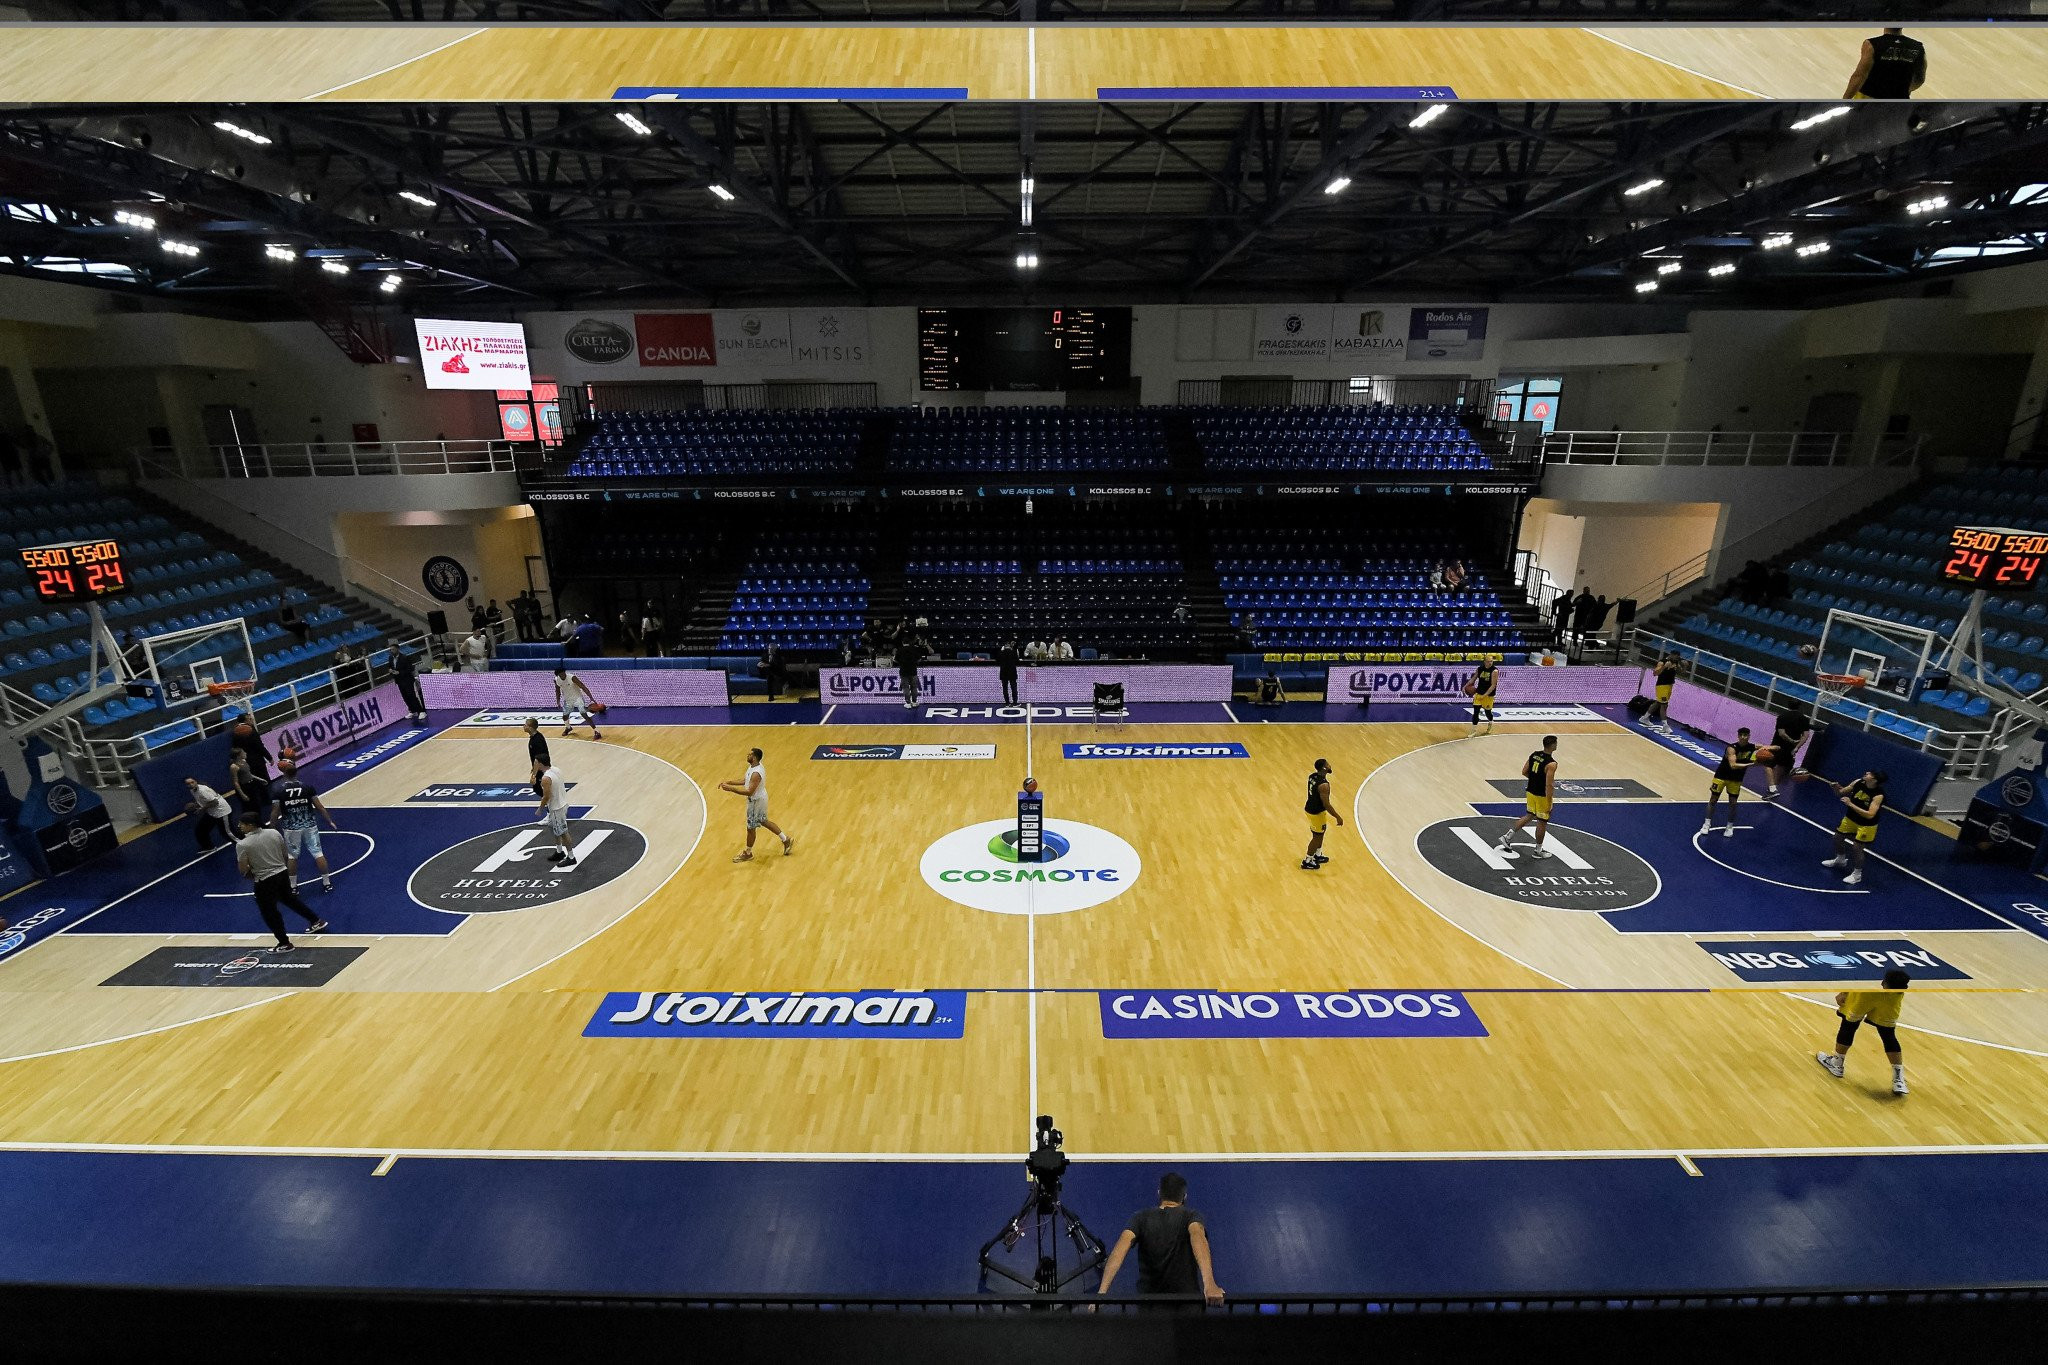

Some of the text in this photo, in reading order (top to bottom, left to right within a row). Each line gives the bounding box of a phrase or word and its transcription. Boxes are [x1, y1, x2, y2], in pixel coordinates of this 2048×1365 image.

[1419, 90, 1446, 98] 21+
[1426, 311, 1454, 322] Rodos
[424, 335, 483, 353] ΖΙΑΚΗΣ
[572, 335, 621, 347] CRETA
[719, 338, 788, 348] SUN BEACH
[1258, 340, 1326, 348] FRAGESKAKIS
[1334, 338, 1404, 348] ΚΑΒΑΣΙΛΑ
[644, 348, 711, 361] CANDIA
[799, 346, 862, 360] MITSIS
[480, 362, 526, 370] www.ziakis.gr
[1950, 529, 2002, 551] 55:00
[22, 542, 120, 568] 55:00 55:00
[1945, 550, 2040, 580] 24 24
[36, 562, 124, 595] 24 24
[298, 696, 384, 748] ΡΟΥΣΑΛΗ
[335, 728, 418, 770] Stoiximan
[1072, 744, 1231, 756] Stoiximan
[286, 787, 302, 798] 77
[416, 788, 475, 797] NBG
[285, 798, 308, 806] PEPSI
[939, 868, 1120, 882] COSMOTE
[1502, 876, 1614, 886] HOTELS
[453, 879, 562, 888] HOTELS
[1711, 951, 1940, 969] NBG PAY
[608, 992, 934, 1025] Stoiximan
[1112, 993, 1462, 1020] CASINO RODOS
